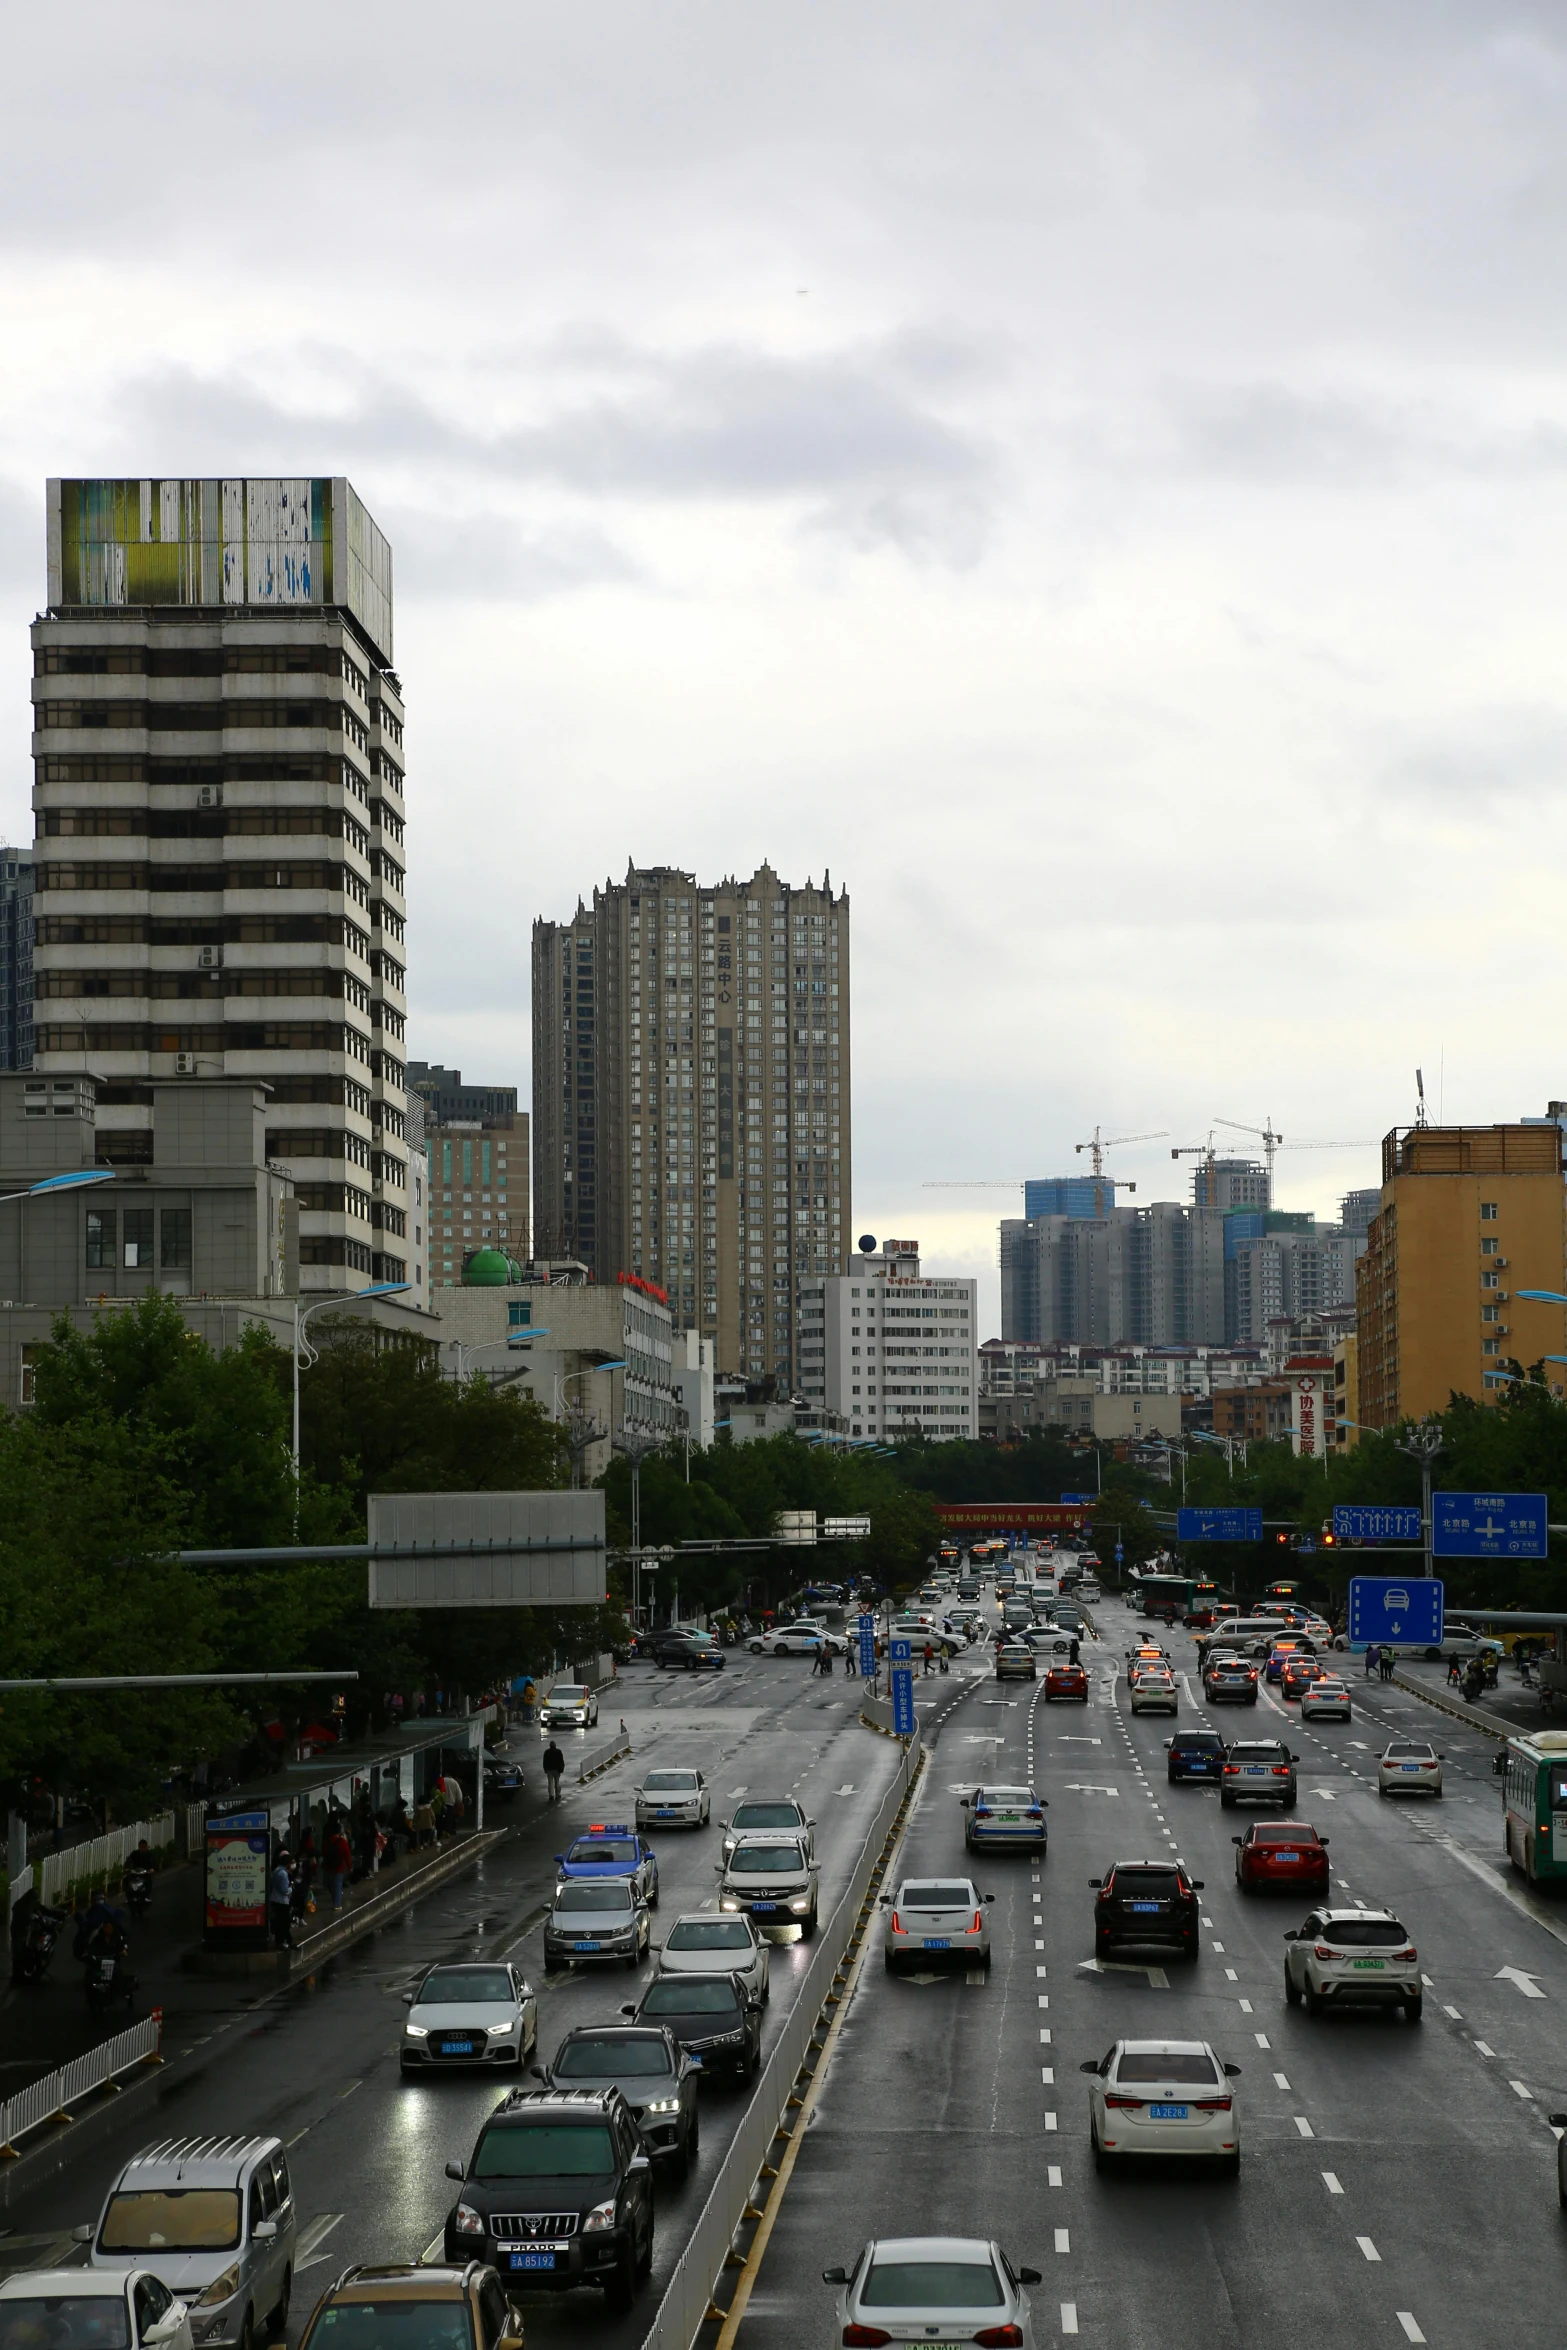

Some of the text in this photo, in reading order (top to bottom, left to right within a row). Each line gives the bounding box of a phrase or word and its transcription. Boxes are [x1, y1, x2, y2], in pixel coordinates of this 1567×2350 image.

[1299, 1395, 1315, 1455] 协美医院
[1474, 1498, 1506, 1507] 环城南路
[1442, 1519, 1470, 1528] 北京路
[1509, 1520, 1537, 1529] 北京路
[899, 1674, 909, 1730] 仅许小型车掉头
[511, 2255, 555, 2268] 云A85192
